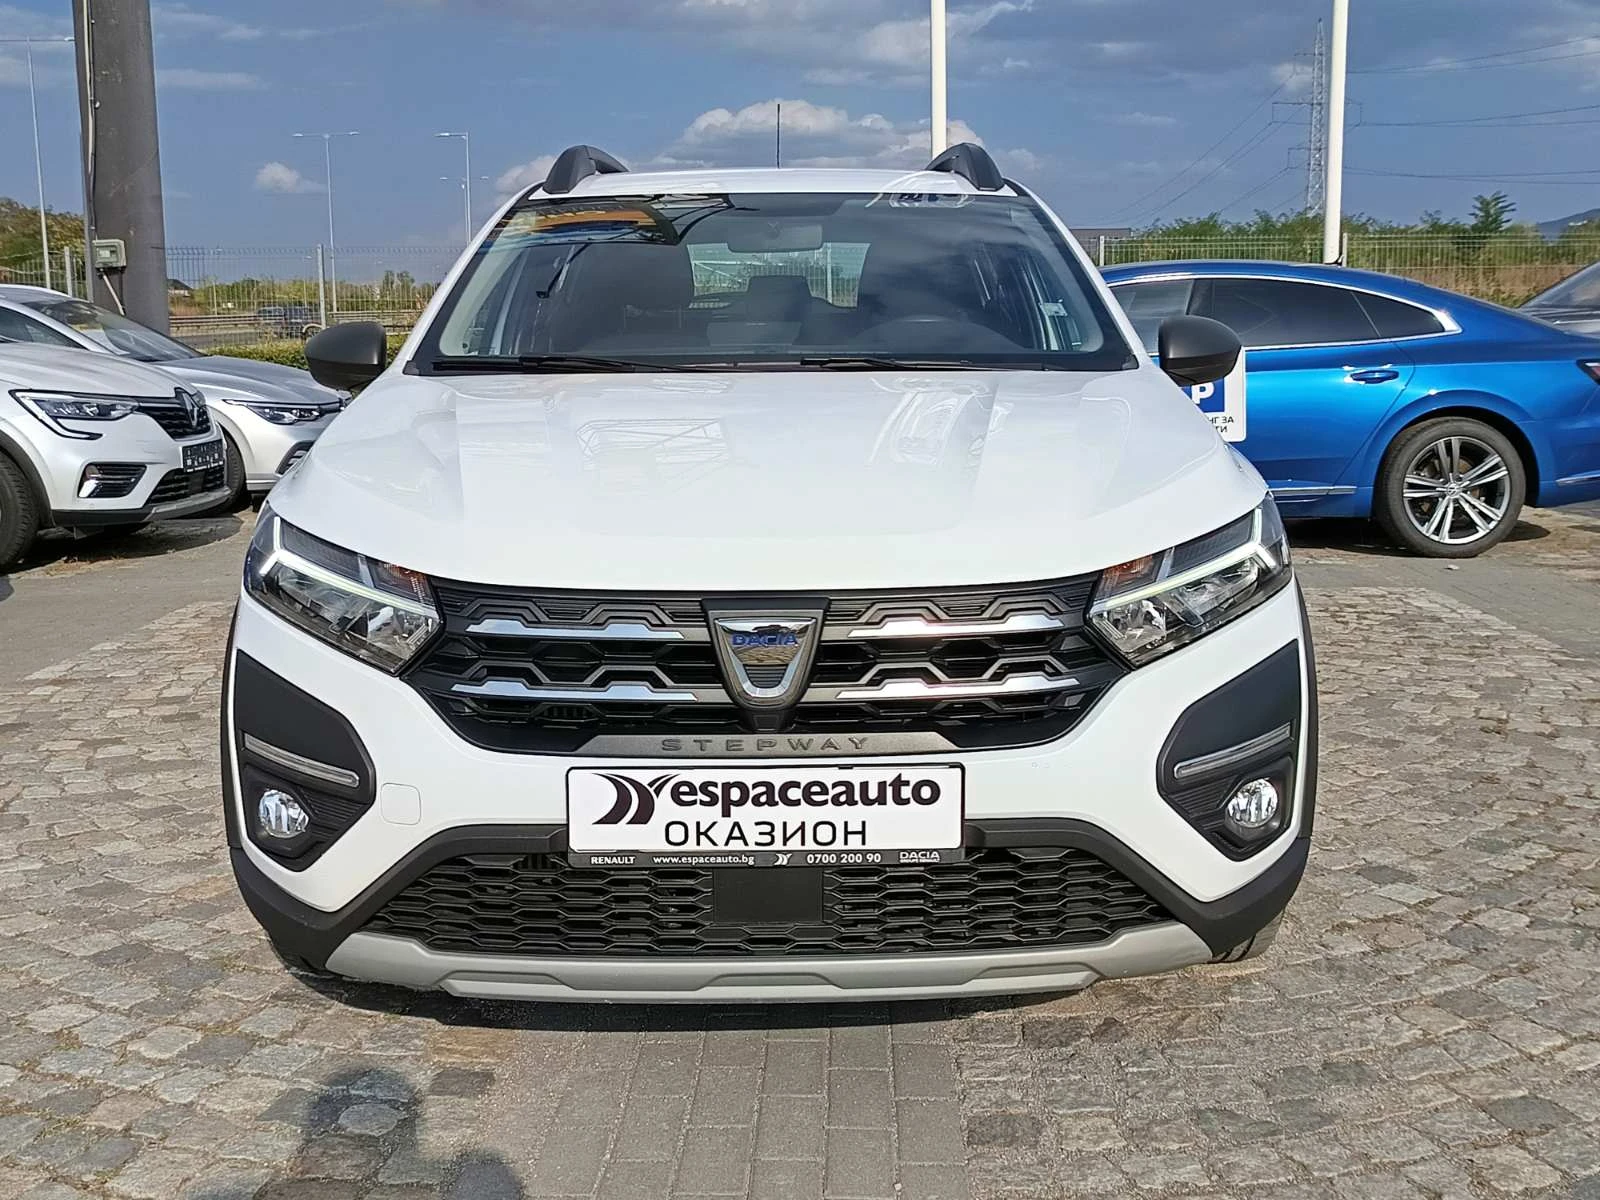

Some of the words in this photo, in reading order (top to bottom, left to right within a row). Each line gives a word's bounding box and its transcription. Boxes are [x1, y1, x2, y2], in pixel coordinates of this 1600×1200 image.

[661, 736, 869, 752] STEPWAY
[669, 773, 942, 818] espaceauto
[664, 820, 867, 847] ОКАЗИОН
[590, 856, 636, 865] RENAULT
[652, 854, 755, 866] www.espaceauto.bg
[806, 853, 837, 864] 0700
[840, 853, 863, 863] 200
[866, 853, 882, 863] 90
[899, 851, 940, 860] DACIA
